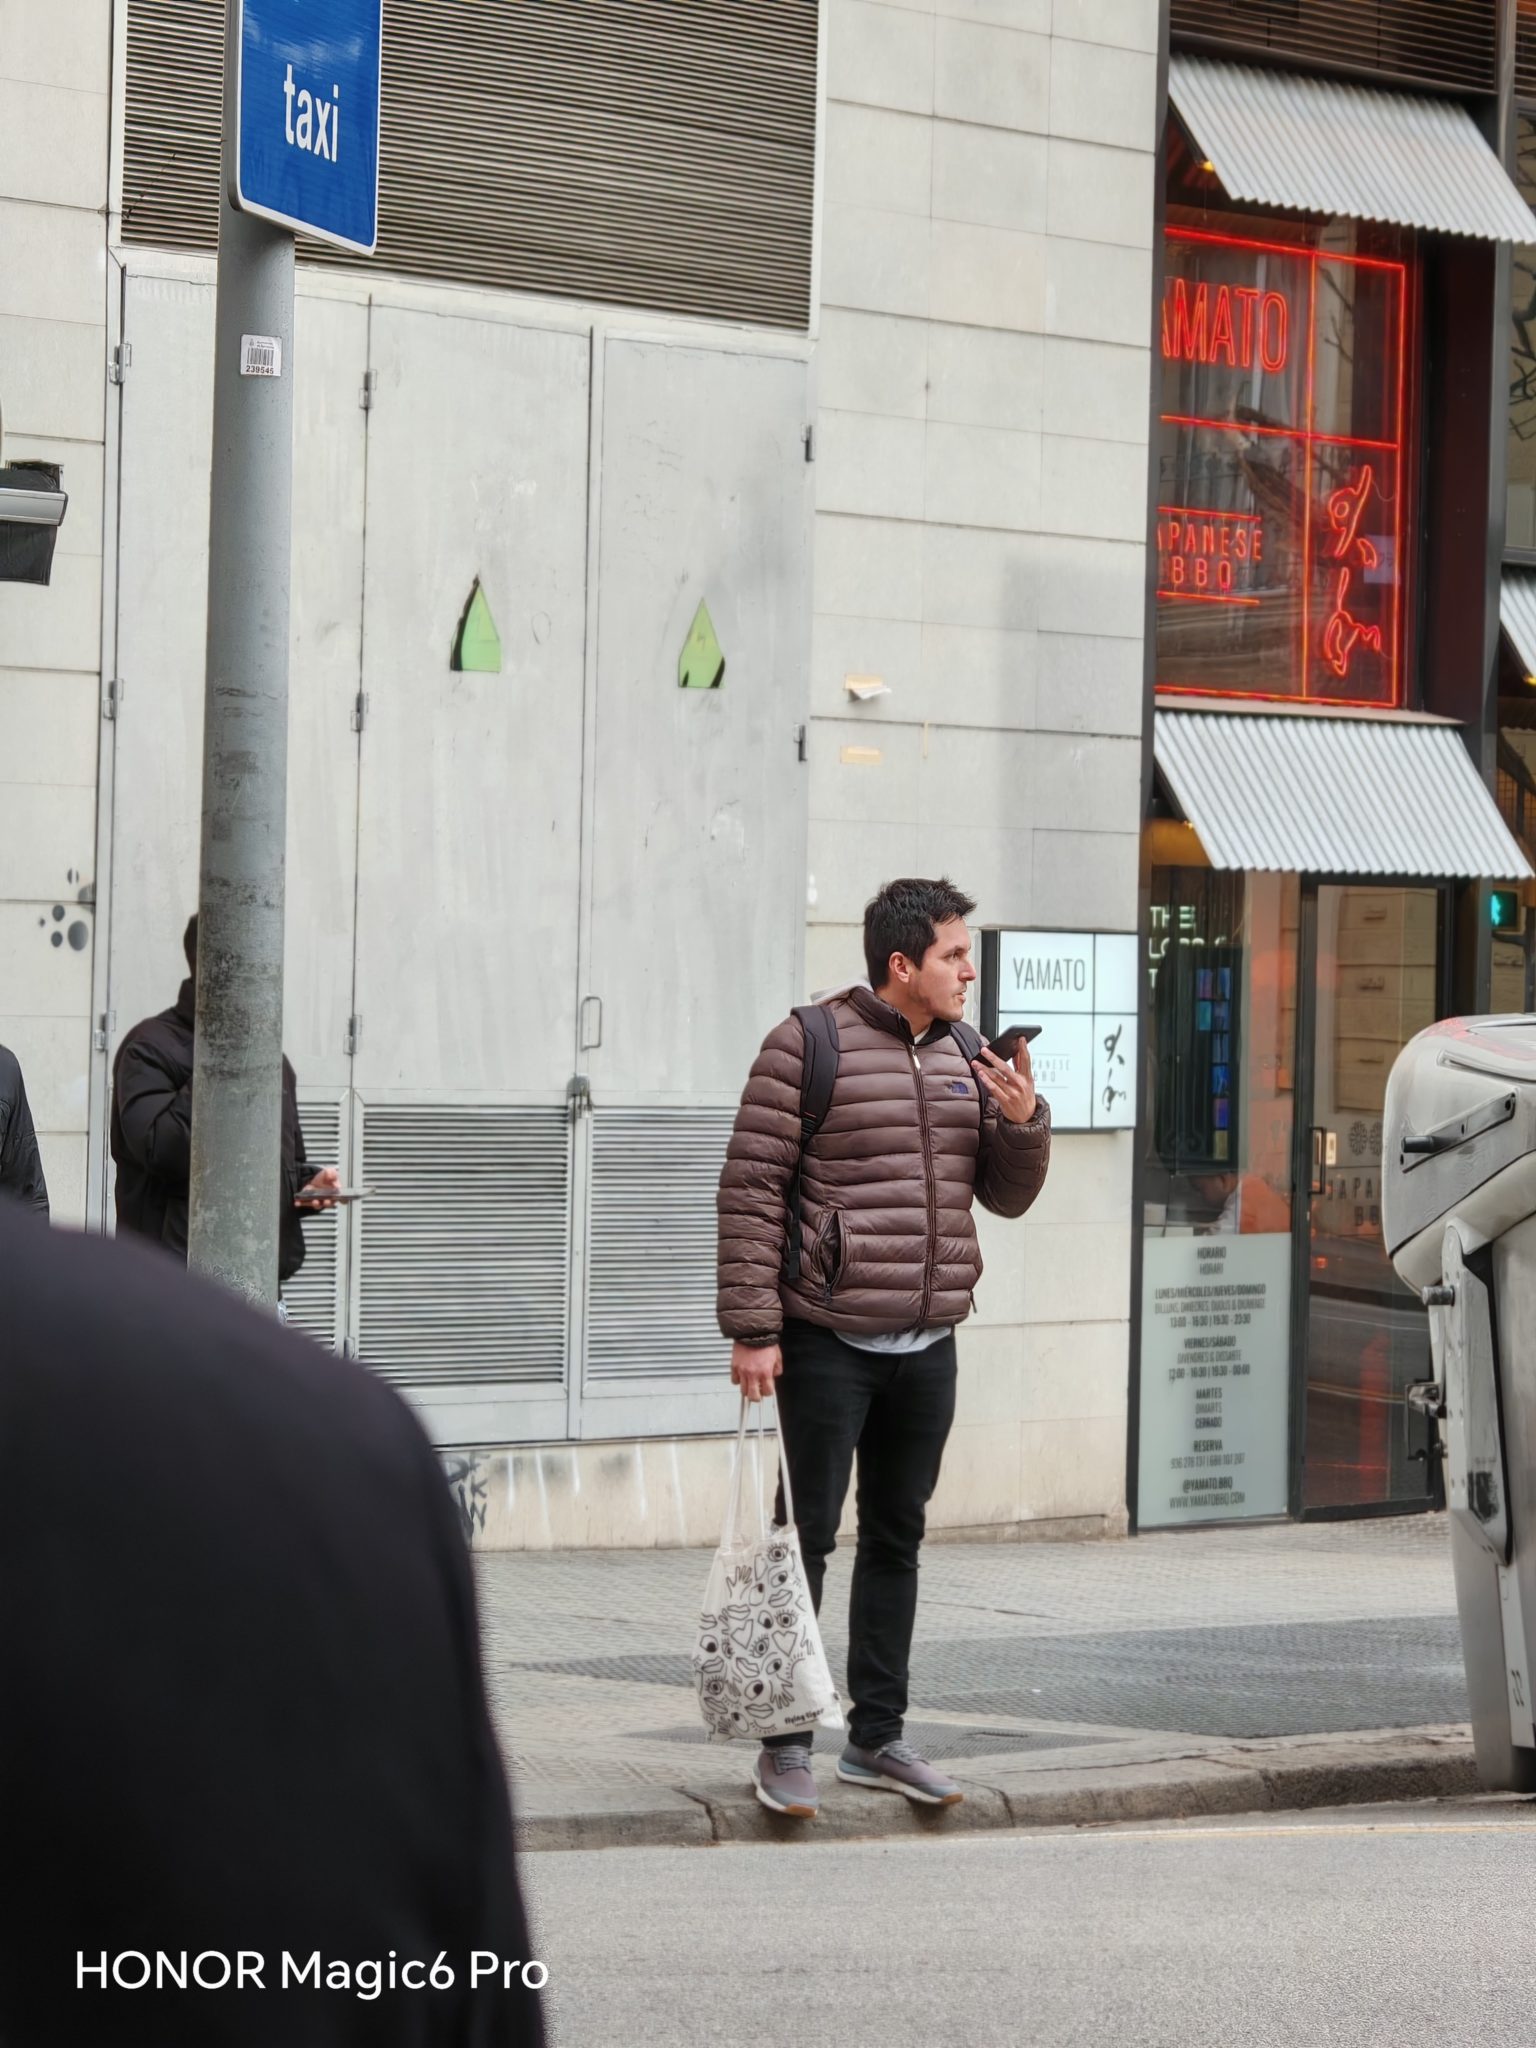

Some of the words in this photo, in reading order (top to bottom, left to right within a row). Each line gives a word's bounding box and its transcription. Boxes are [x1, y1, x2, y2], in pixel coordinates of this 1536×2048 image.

[283, 63, 339, 163] taxi
[246, 365, 274, 374] 239545
[1171, 555, 1232, 590] BBQ
[1013, 956, 1086, 992] YAMATO
[1197, 1246, 1227, 1260] HORARIO
[1196, 1387, 1222, 1400] MARTES
[1193, 1440, 1223, 1452] RESERVA
[805, 1707, 824, 1719] tiger
